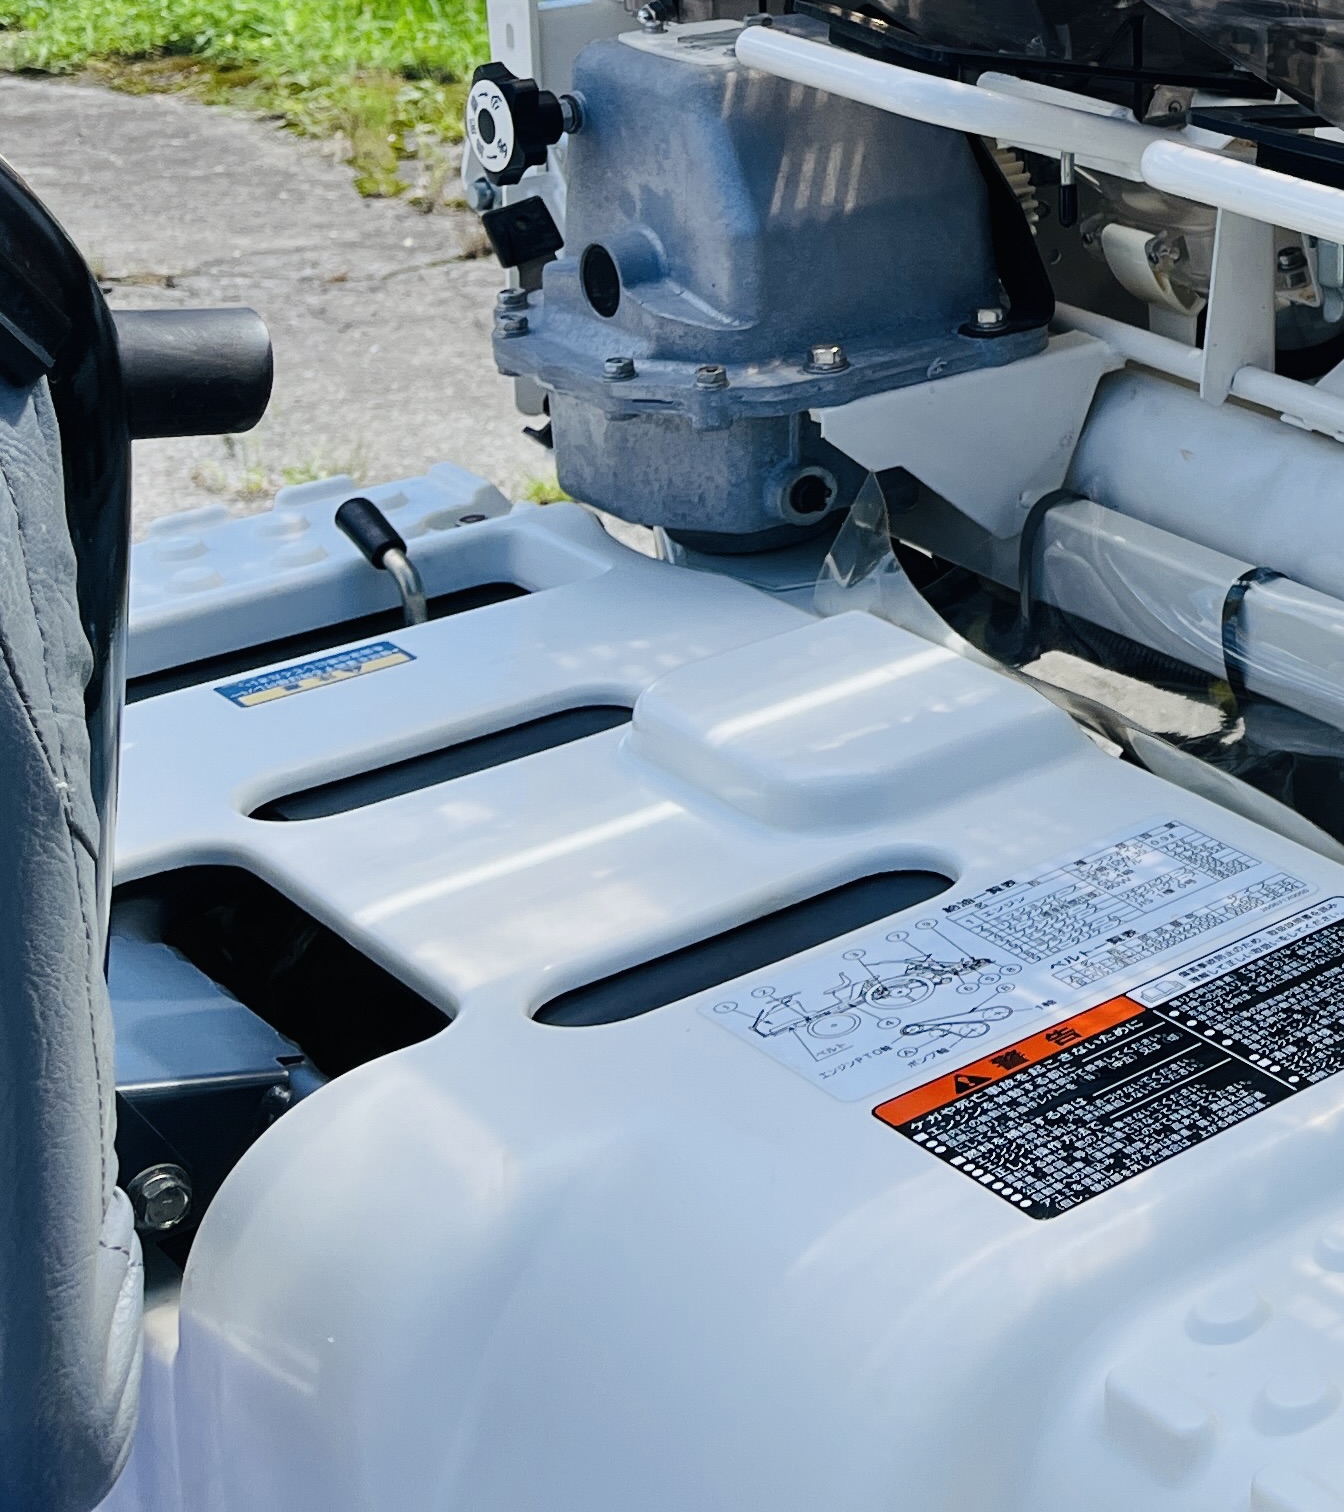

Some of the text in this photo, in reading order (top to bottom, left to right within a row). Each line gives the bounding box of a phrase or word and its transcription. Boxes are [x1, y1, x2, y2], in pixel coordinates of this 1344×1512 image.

[907, 1018, 1145, 1132] ケガや死亡事故を起こさないために
[987, 1024, 1083, 1072] 警告
[924, 1062, 1077, 1136] エンジンを始動する前に
